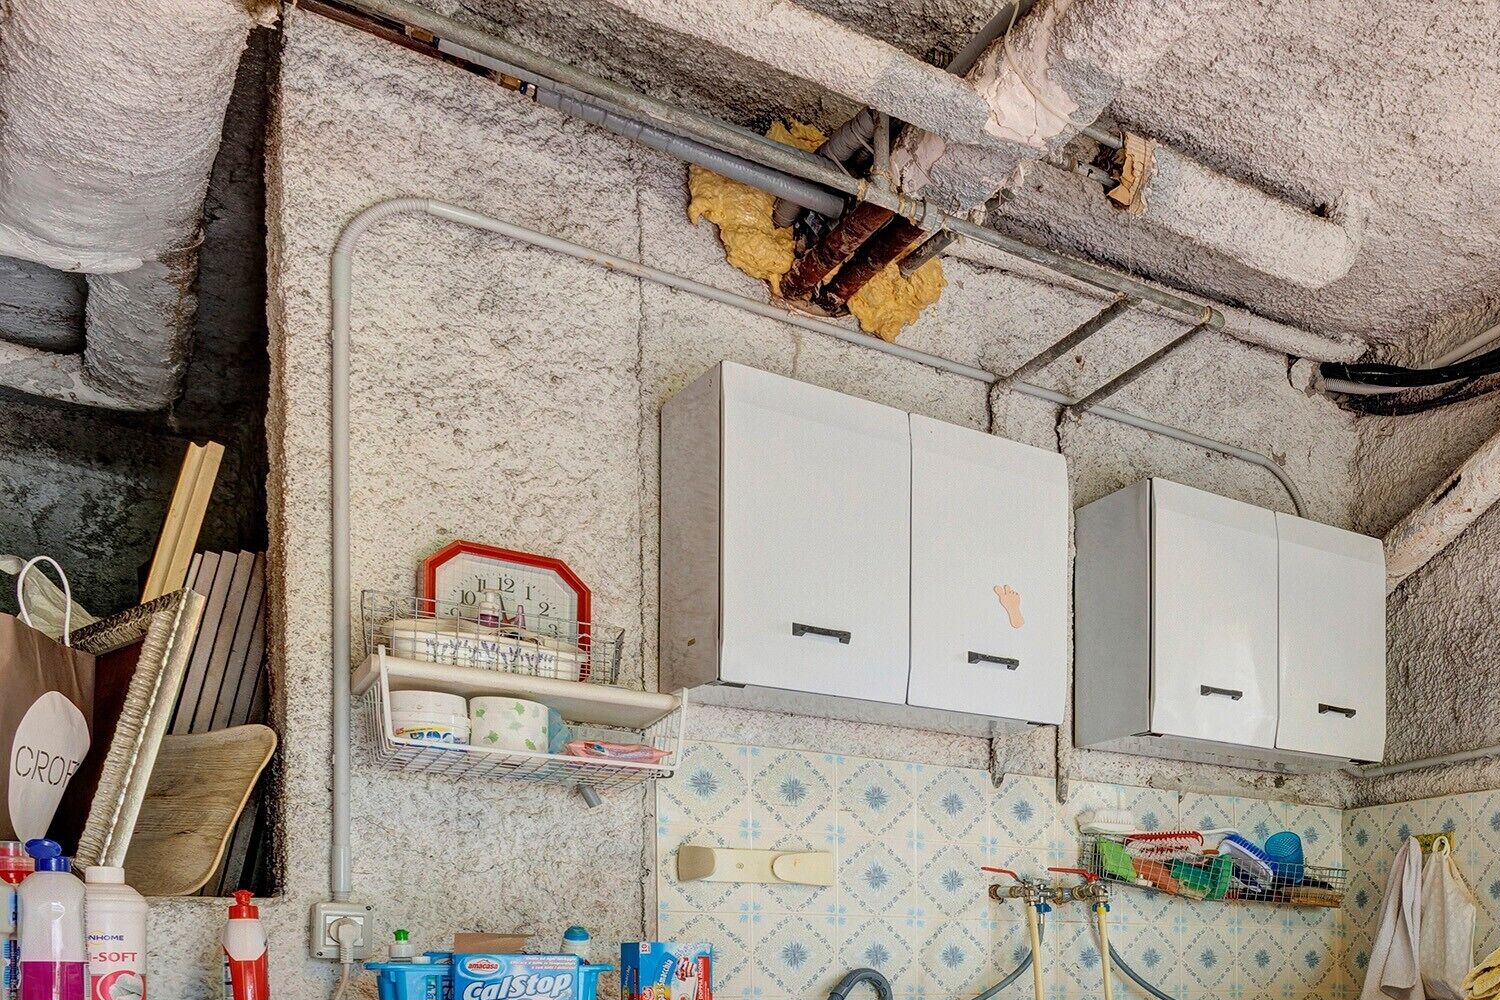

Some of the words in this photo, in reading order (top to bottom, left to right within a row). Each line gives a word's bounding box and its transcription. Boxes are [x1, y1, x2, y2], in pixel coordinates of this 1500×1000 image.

[460, 589, 476, 606] 10
[477, 578, 486, 593] 11
[498, 577, 515, 594] 12
[539, 601, 550, 617] 2
[467, 962, 499, 971] amacasa
